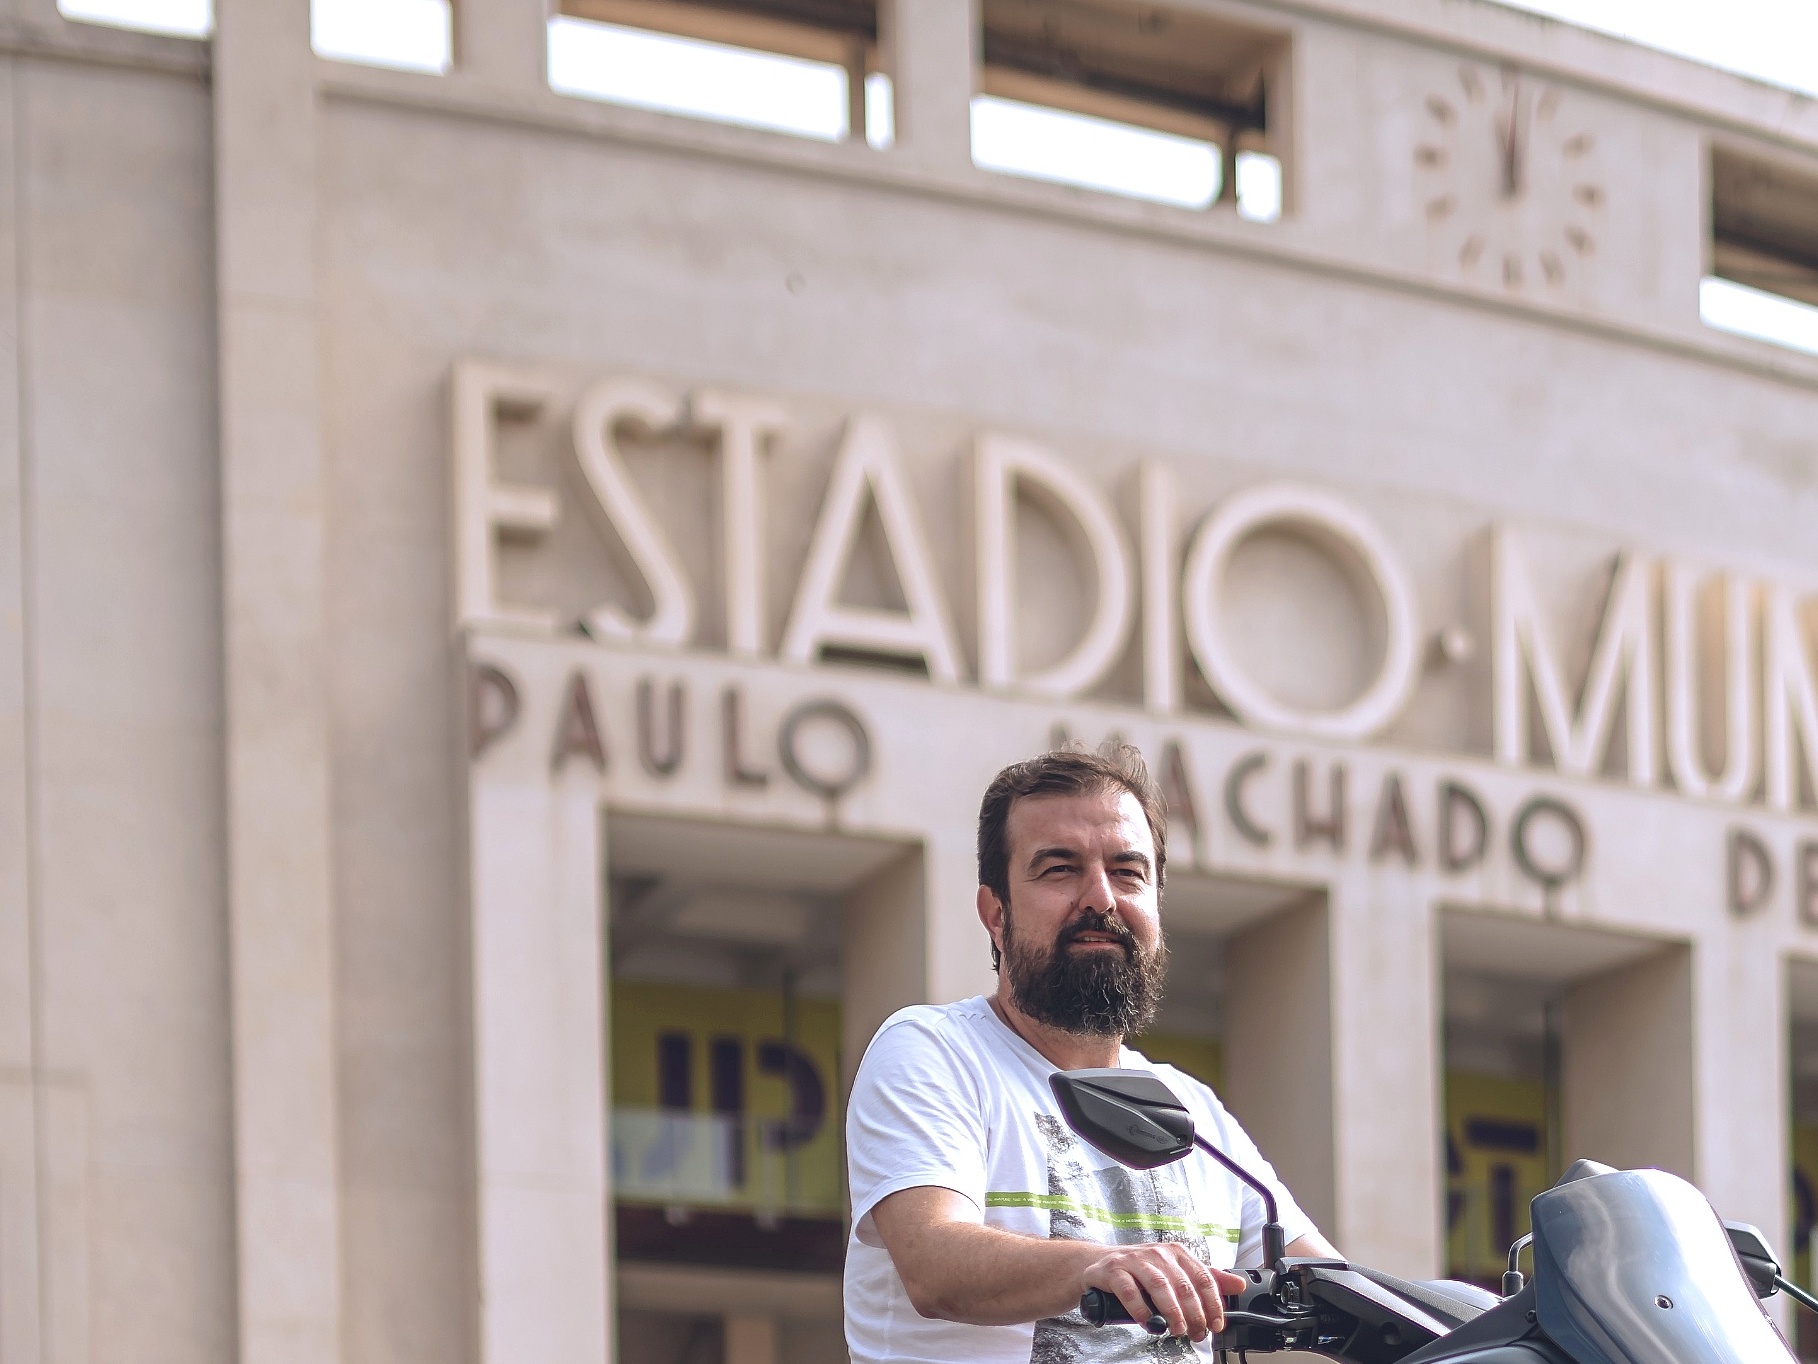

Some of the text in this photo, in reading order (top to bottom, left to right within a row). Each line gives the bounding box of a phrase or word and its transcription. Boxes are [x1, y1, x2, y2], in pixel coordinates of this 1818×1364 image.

[456, 360, 1416, 738] ESTADIO
[471, 662, 870, 798] PAULO
[1048, 724, 1591, 888] ACHADO
